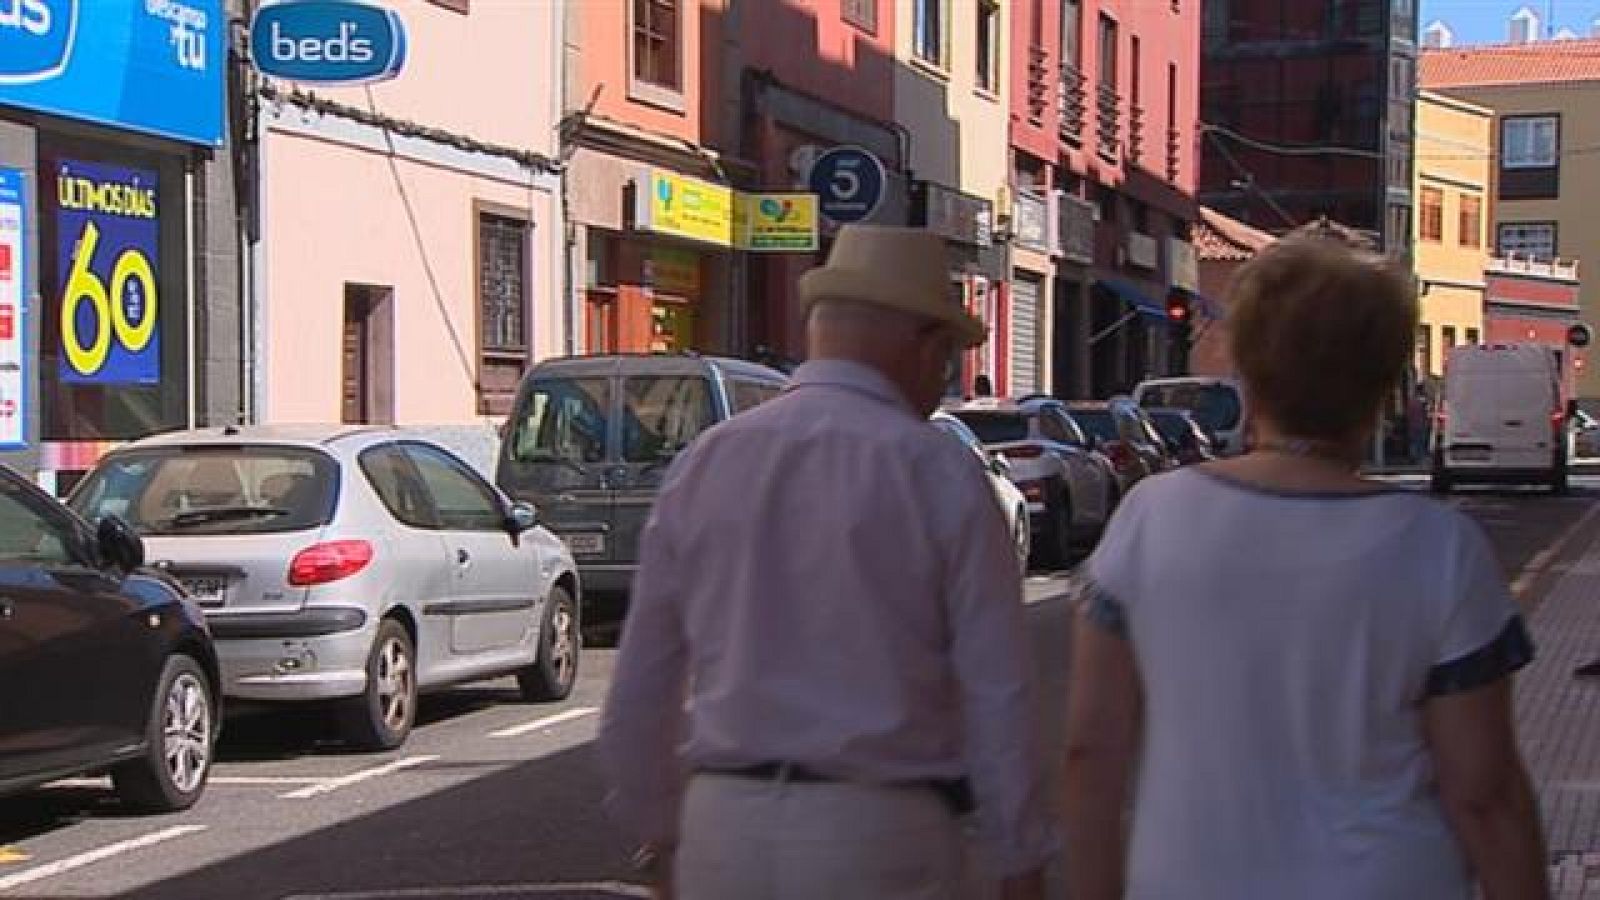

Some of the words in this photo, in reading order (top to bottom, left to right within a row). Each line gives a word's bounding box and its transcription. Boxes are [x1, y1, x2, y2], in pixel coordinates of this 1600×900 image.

[271, 21, 374, 62] bed's
[829, 158, 860, 200] 5
[61, 219, 158, 375] 60
